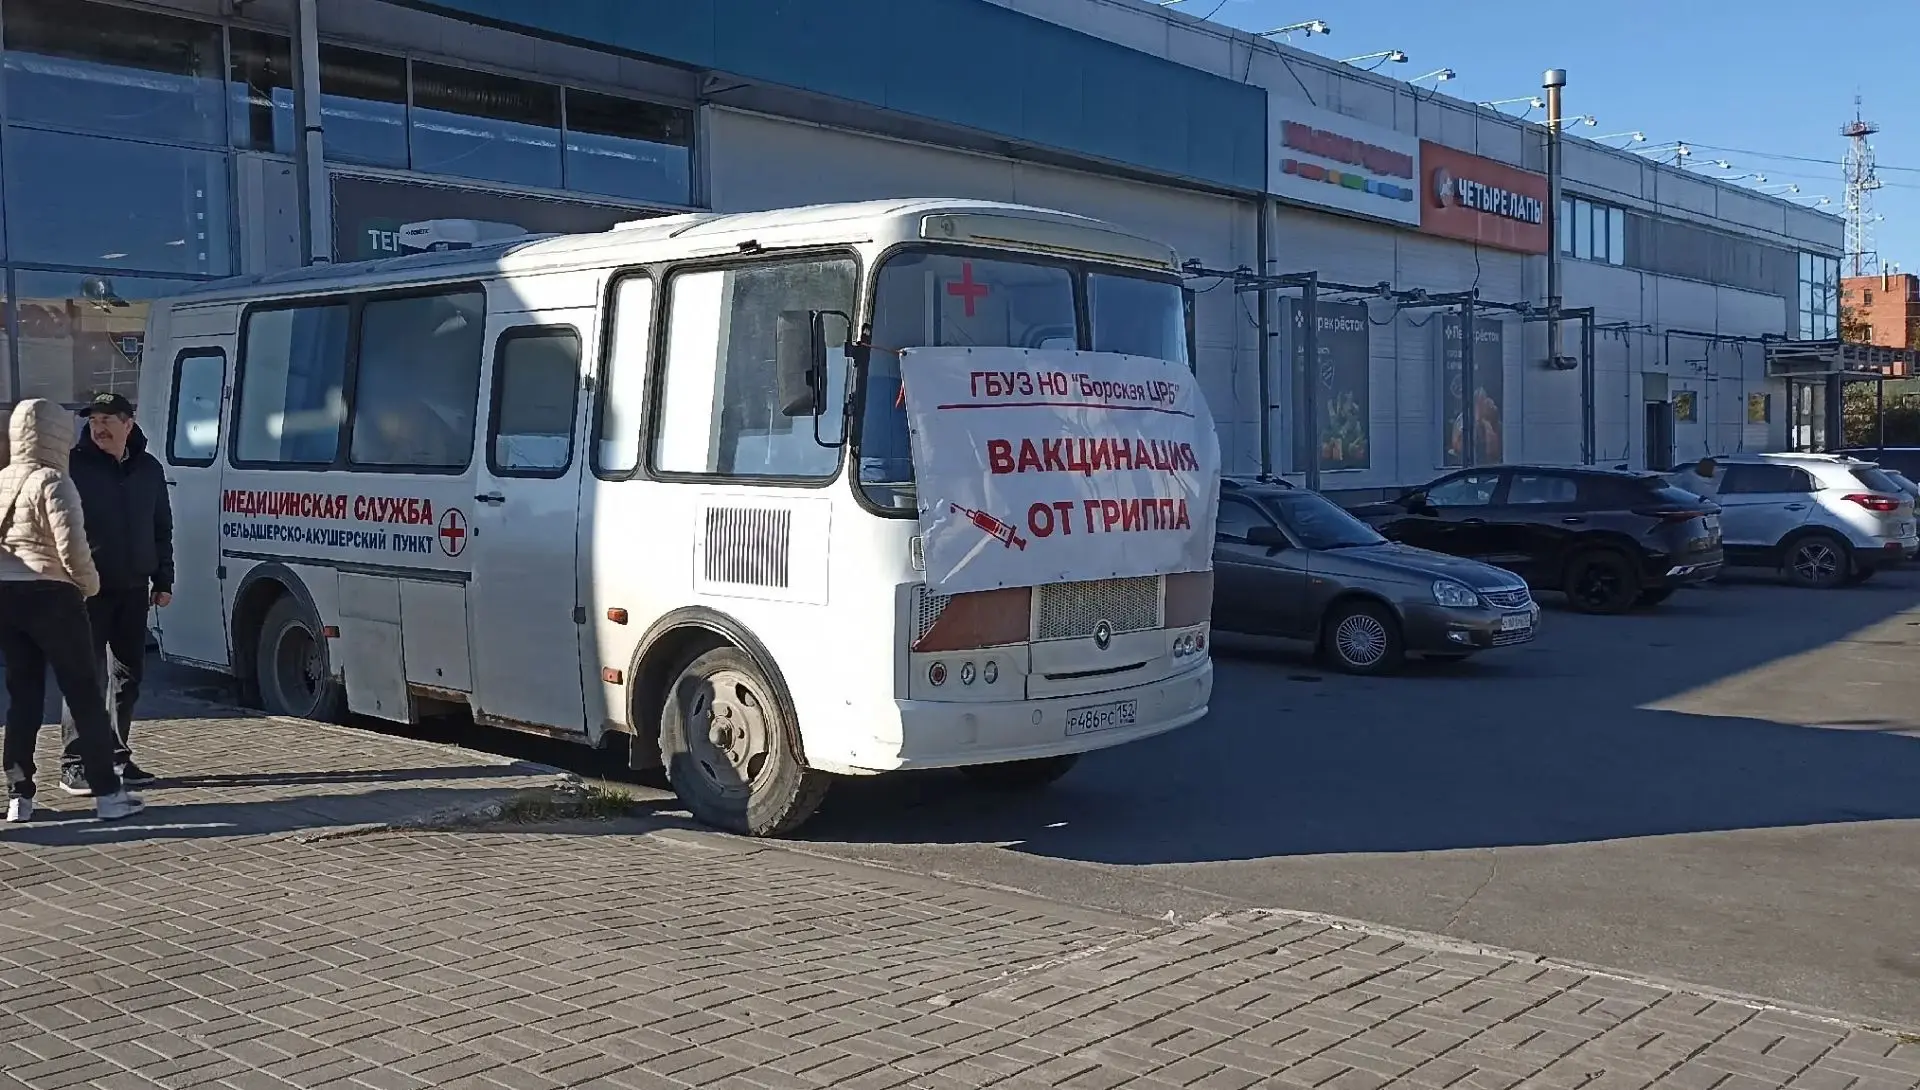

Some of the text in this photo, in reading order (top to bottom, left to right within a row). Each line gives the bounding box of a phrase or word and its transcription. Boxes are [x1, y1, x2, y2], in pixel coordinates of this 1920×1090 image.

[1459, 178, 1543, 225] ЧЕТЫРЕ ЛАПЫ
[1316, 315, 1365, 332] рекрёсток
[970, 371, 1034, 397] ГБУЗ
[1038, 371, 1068, 395] НО
[987, 438, 1200, 477] ВАКЦИНАЦИЯ
[223, 489, 433, 525] МЕДИЦИНСКАЯ СЛУЖБА
[1027, 498, 1190, 538] ОТ ГРИППА
[223, 522, 433, 554] ФЕЛЬДШЕРСКО-АКУШЕРСКИЙ ПУНКТ
